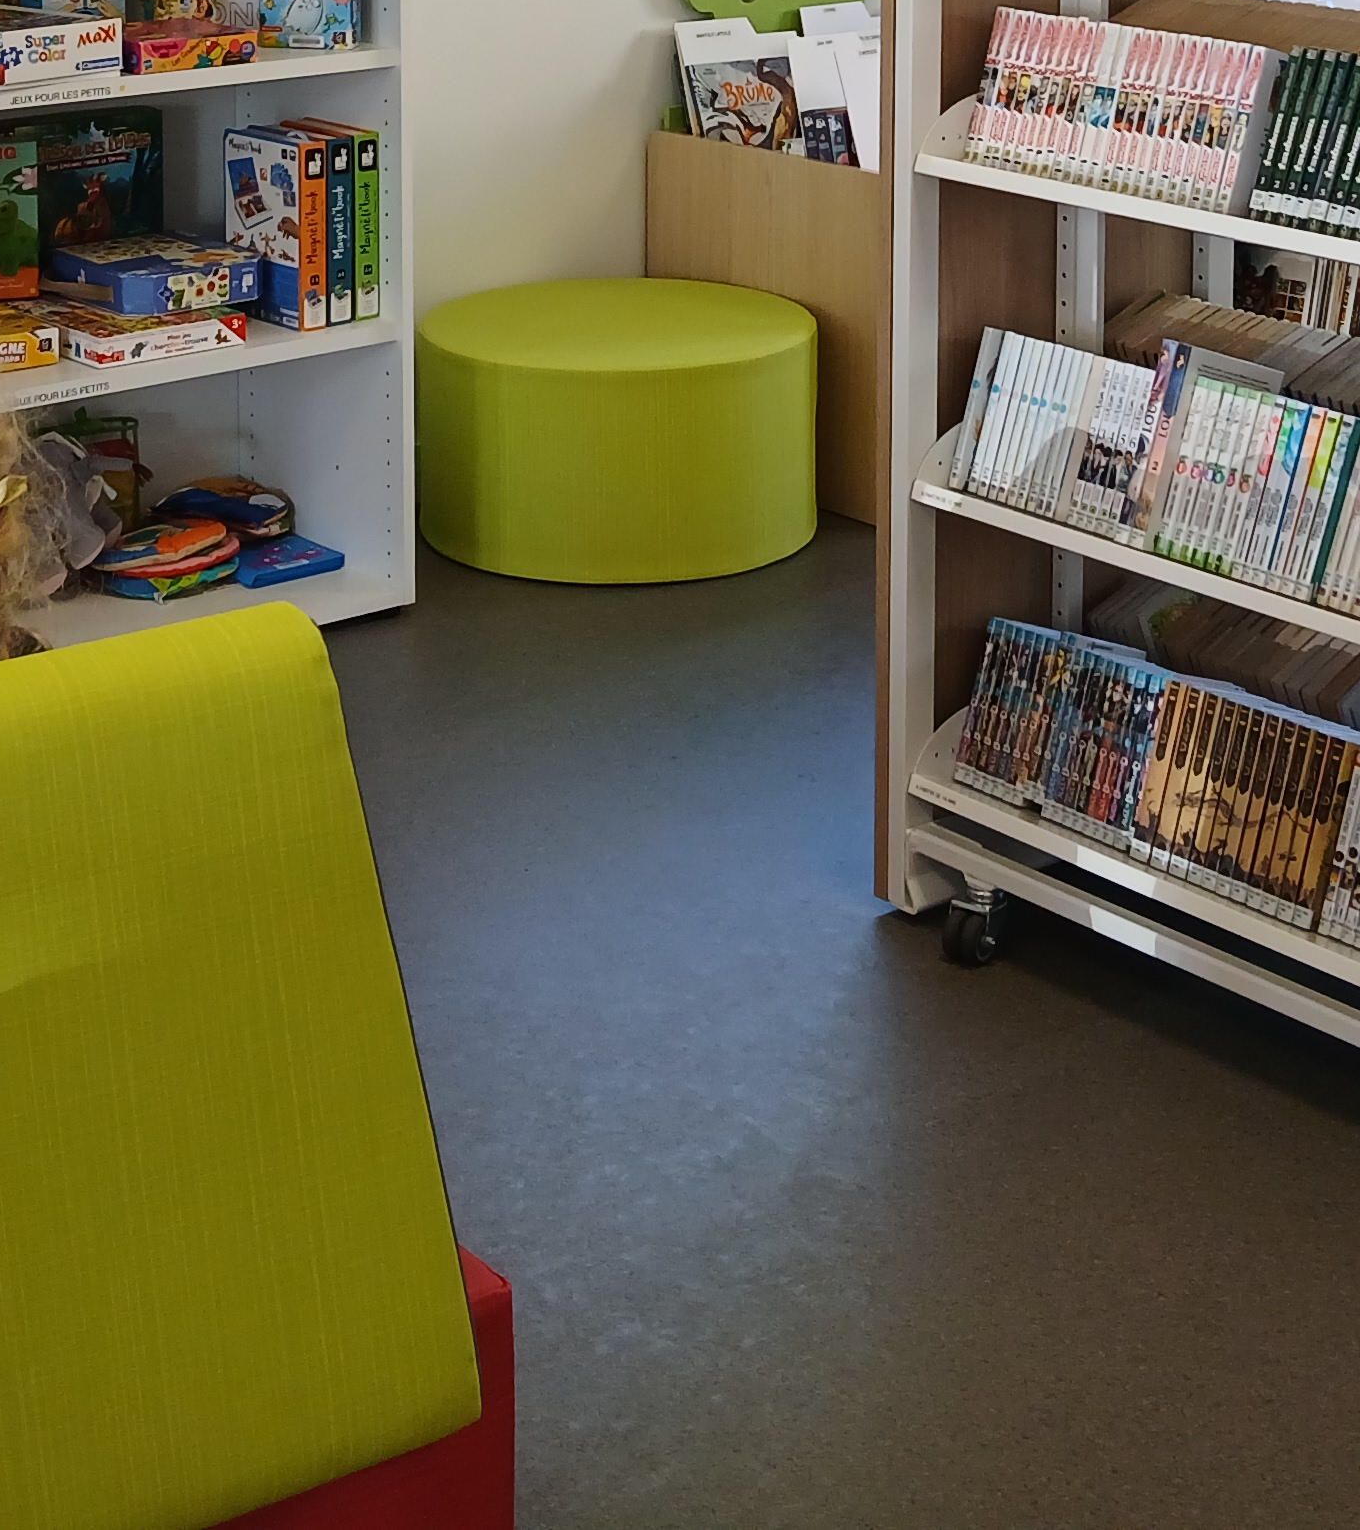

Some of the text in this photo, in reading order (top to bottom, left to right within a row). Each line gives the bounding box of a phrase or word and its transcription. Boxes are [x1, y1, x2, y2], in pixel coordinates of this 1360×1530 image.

[25, 33, 65, 50] Super
[28, 48, 67, 64] Color
[10, 87, 111, 105] JEUX POUR LES PETITS
[34, 382, 110, 403] POUR LES PETITS
